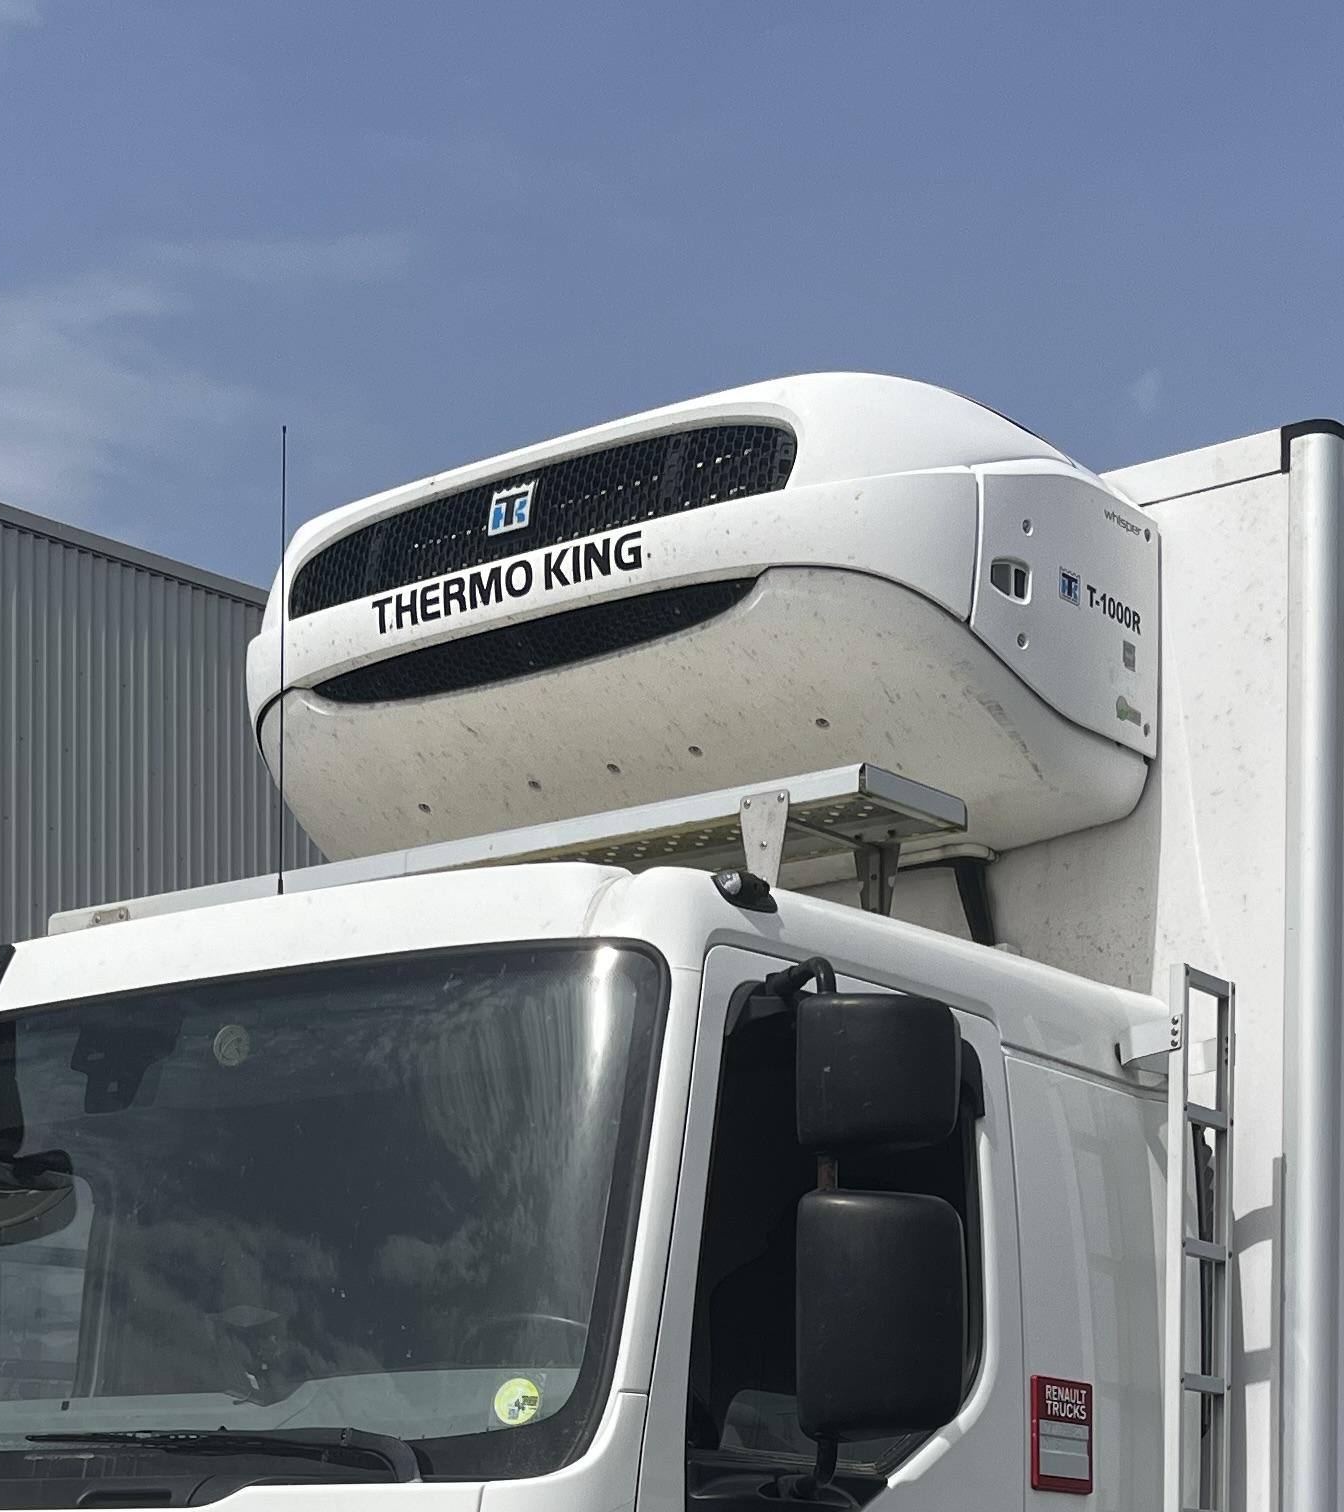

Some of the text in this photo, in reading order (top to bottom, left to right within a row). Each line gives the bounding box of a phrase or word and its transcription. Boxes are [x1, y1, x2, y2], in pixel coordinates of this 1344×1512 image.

[1104, 508, 1142, 537] whisper
[371, 530, 643, 634] THERMO KING
[1086, 584, 1142, 636] T-1000R
[1045, 1384, 1087, 1405] RENAULT
[1045, 1399, 1087, 1420] TRUCKS
